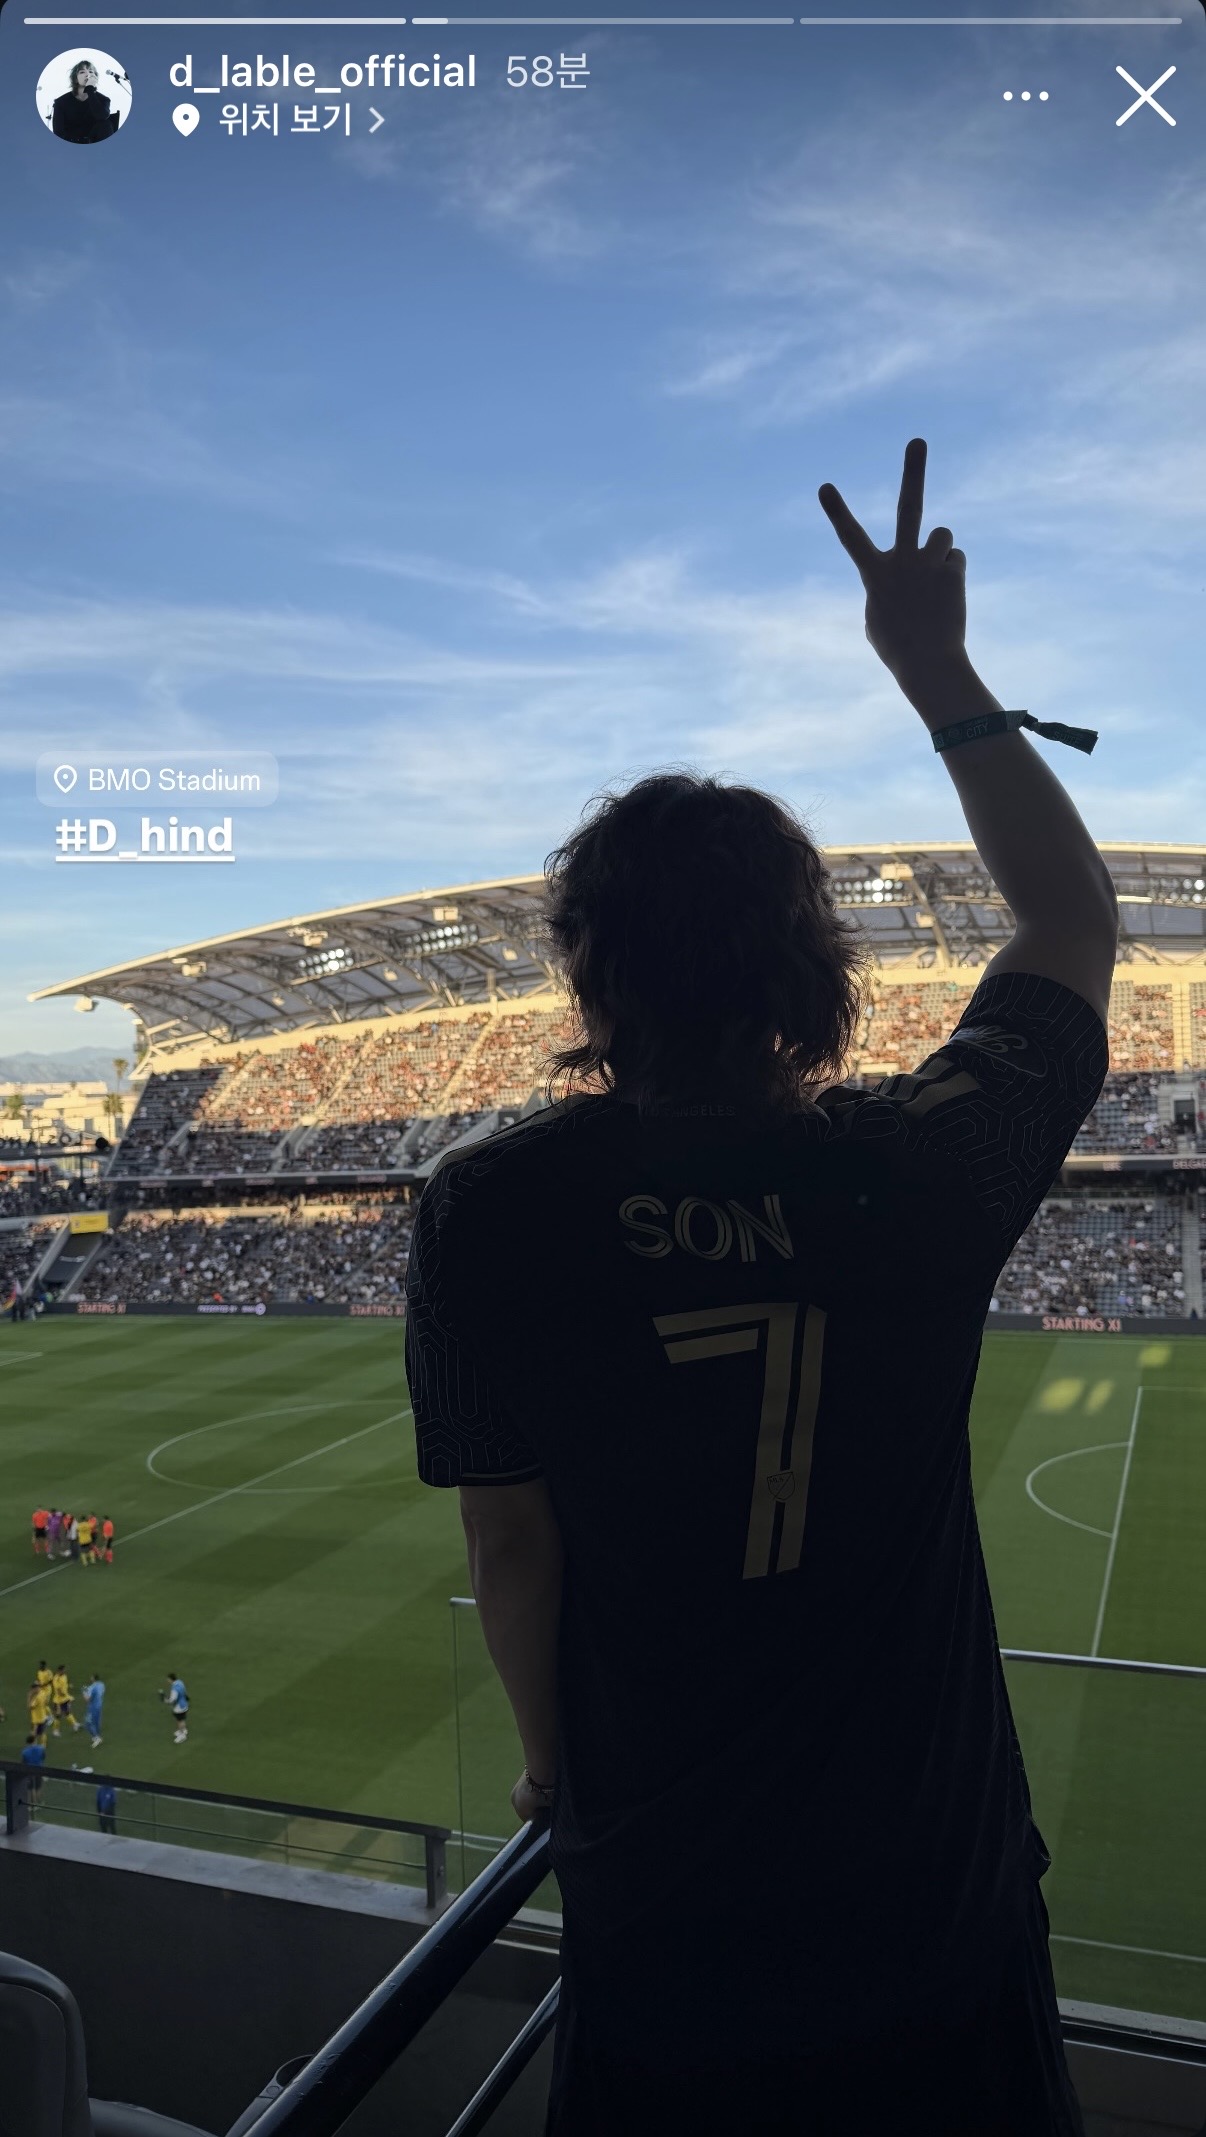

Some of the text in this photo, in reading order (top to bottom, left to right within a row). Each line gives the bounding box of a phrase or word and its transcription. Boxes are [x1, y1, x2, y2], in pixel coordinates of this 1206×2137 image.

[618, 1193, 796, 1263] SON
[1041, 1315, 1122, 1333] STARTING XI
[652, 1302, 828, 1580] 7
